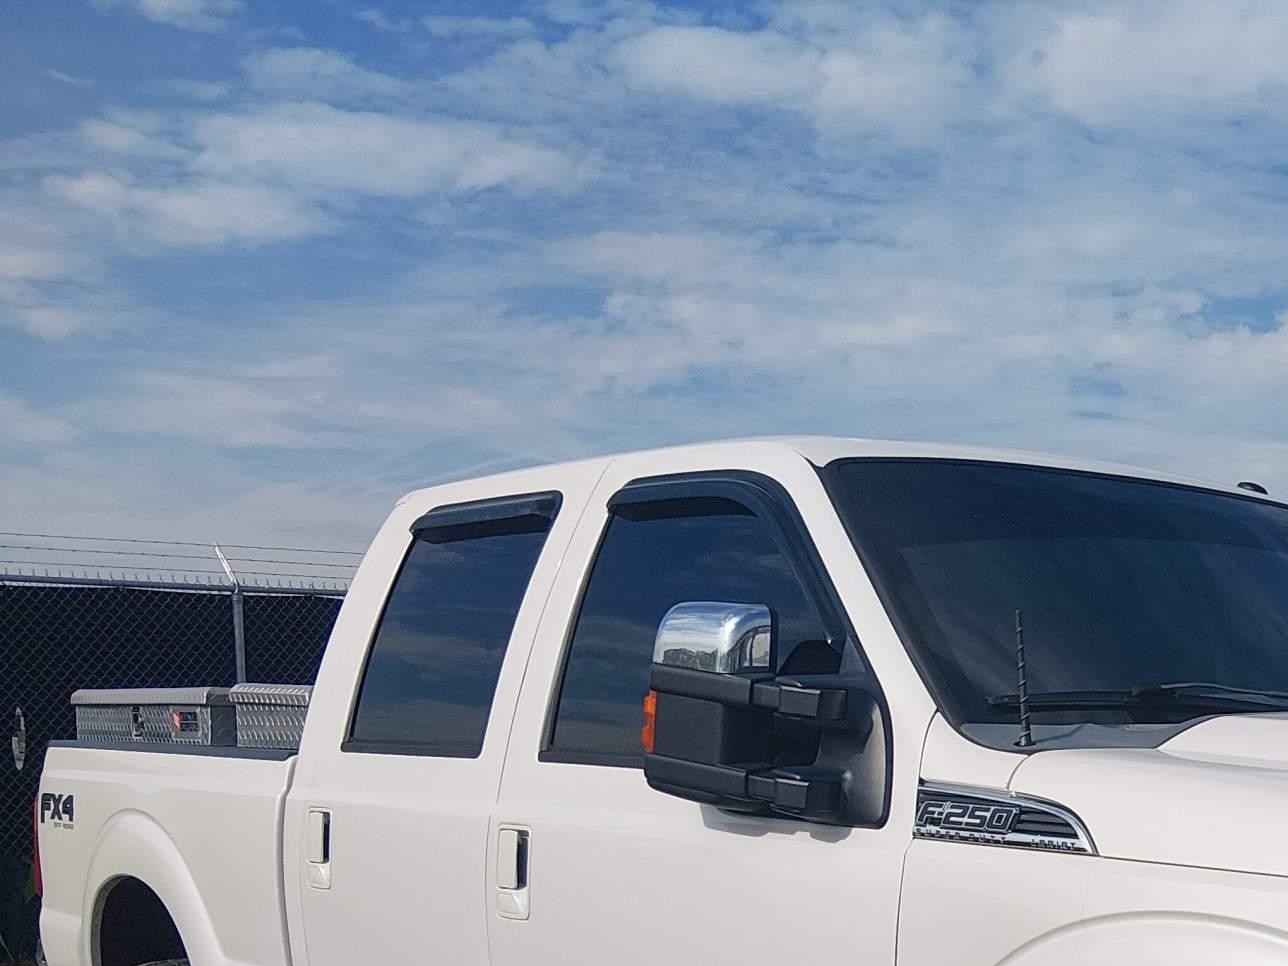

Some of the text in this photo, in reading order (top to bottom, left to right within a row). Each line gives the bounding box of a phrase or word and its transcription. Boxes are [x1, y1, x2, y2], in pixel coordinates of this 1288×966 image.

[40, 793, 74, 824] FX4
[916, 800, 1020, 834] F-250
[914, 828, 1077, 850] SUPER DUTY LARIAT
